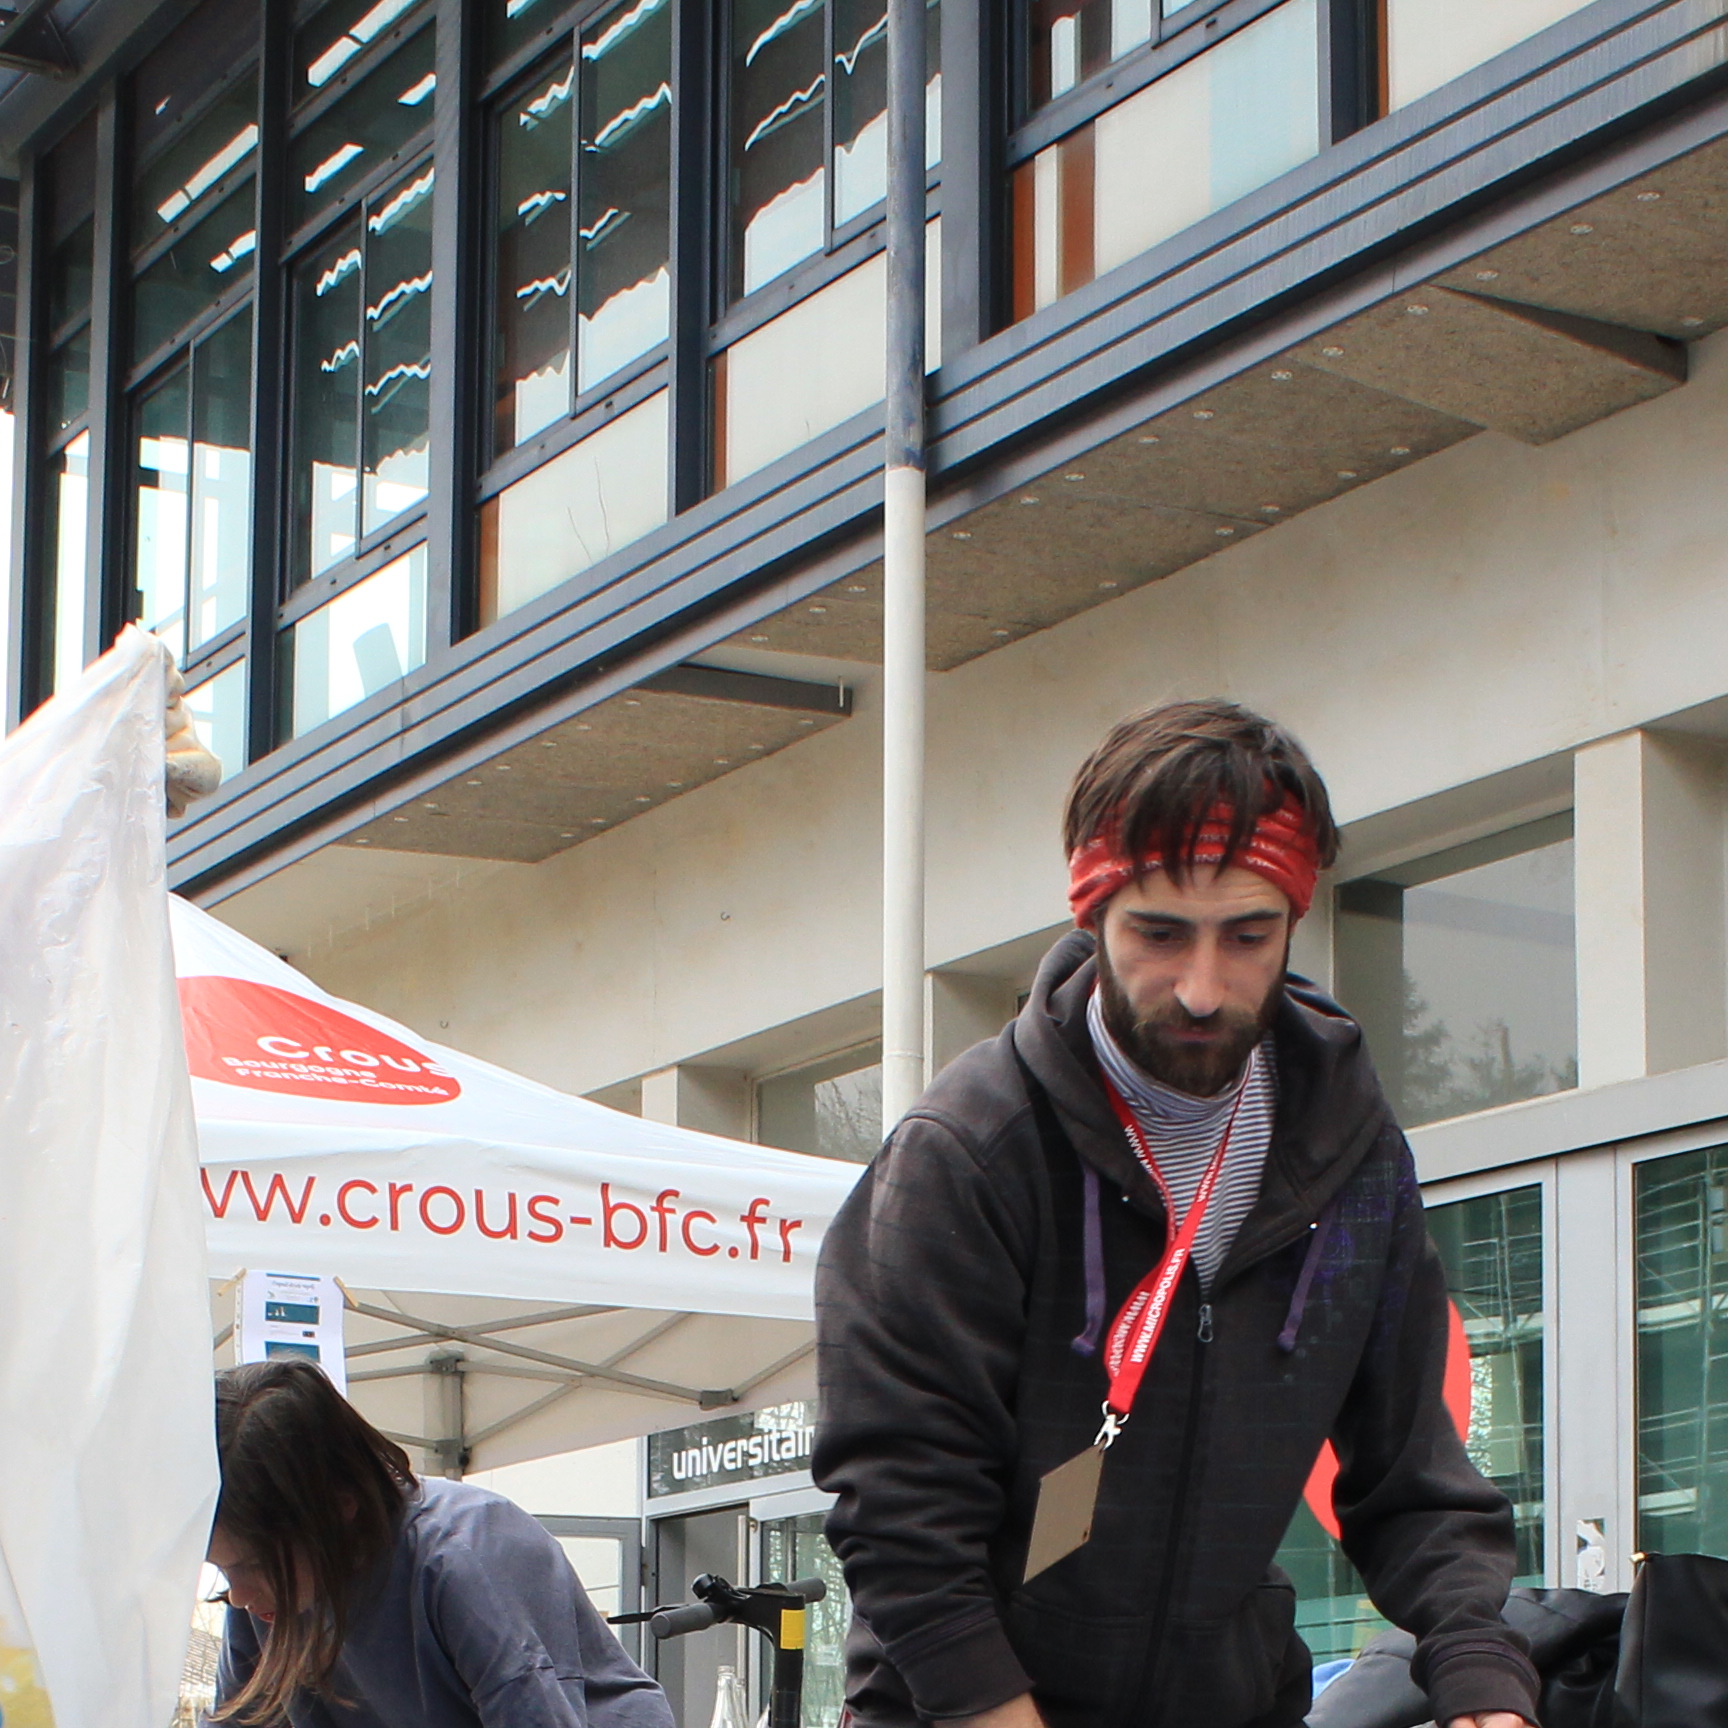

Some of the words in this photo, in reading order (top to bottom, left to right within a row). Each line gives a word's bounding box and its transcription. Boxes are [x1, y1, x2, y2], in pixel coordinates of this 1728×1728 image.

[221, 1056, 377, 1079] Bourgogne
[256, 1035, 456, 1079] Crous
[234, 1067, 450, 1096] Franche-Comté
[1130, 1246, 1186, 1364] WWW.MICROPOLIS.FR
